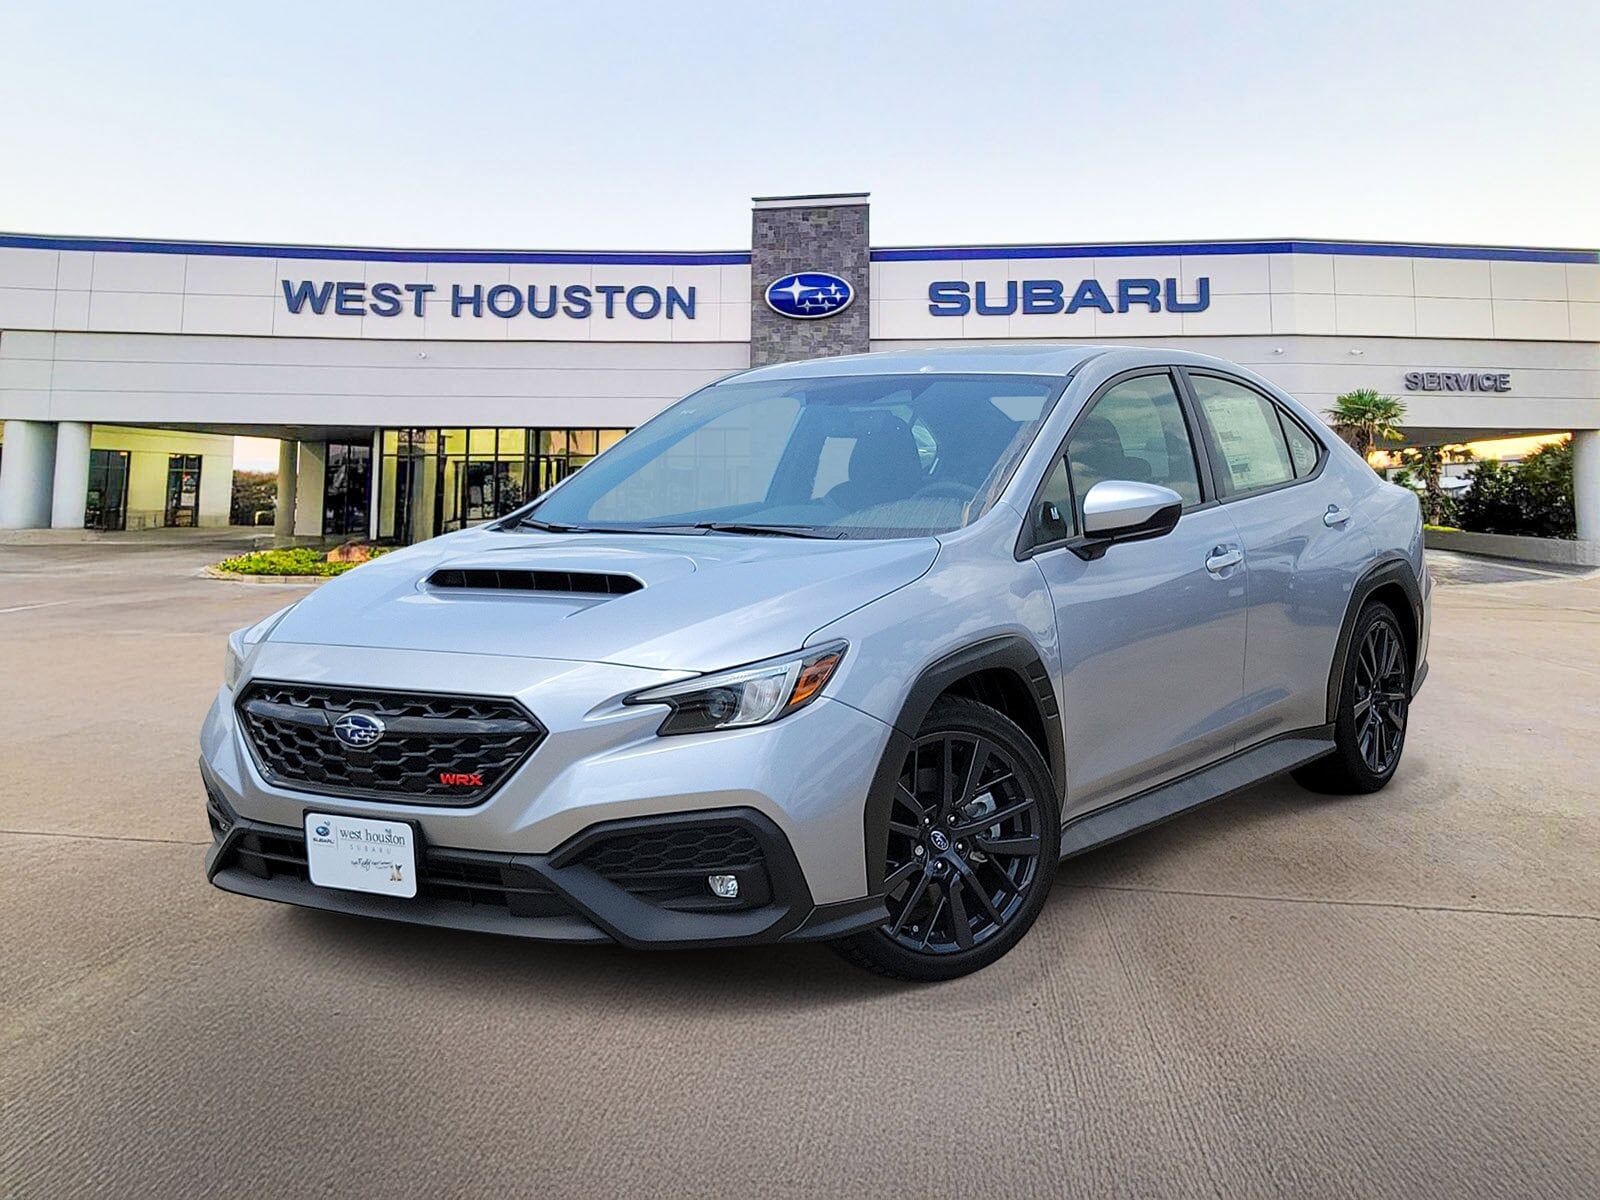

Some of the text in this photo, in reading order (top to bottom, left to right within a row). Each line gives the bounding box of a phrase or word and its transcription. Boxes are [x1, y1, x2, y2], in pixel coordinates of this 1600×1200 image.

[282, 279, 697, 320] WEST HOUSTON
[928, 277, 1211, 316] SUBARU
[1405, 372, 1512, 392] SERVICE
[440, 773, 484, 786] WRX
[339, 828, 406, 846] west houston
[350, 845, 392, 855] SUBARU
